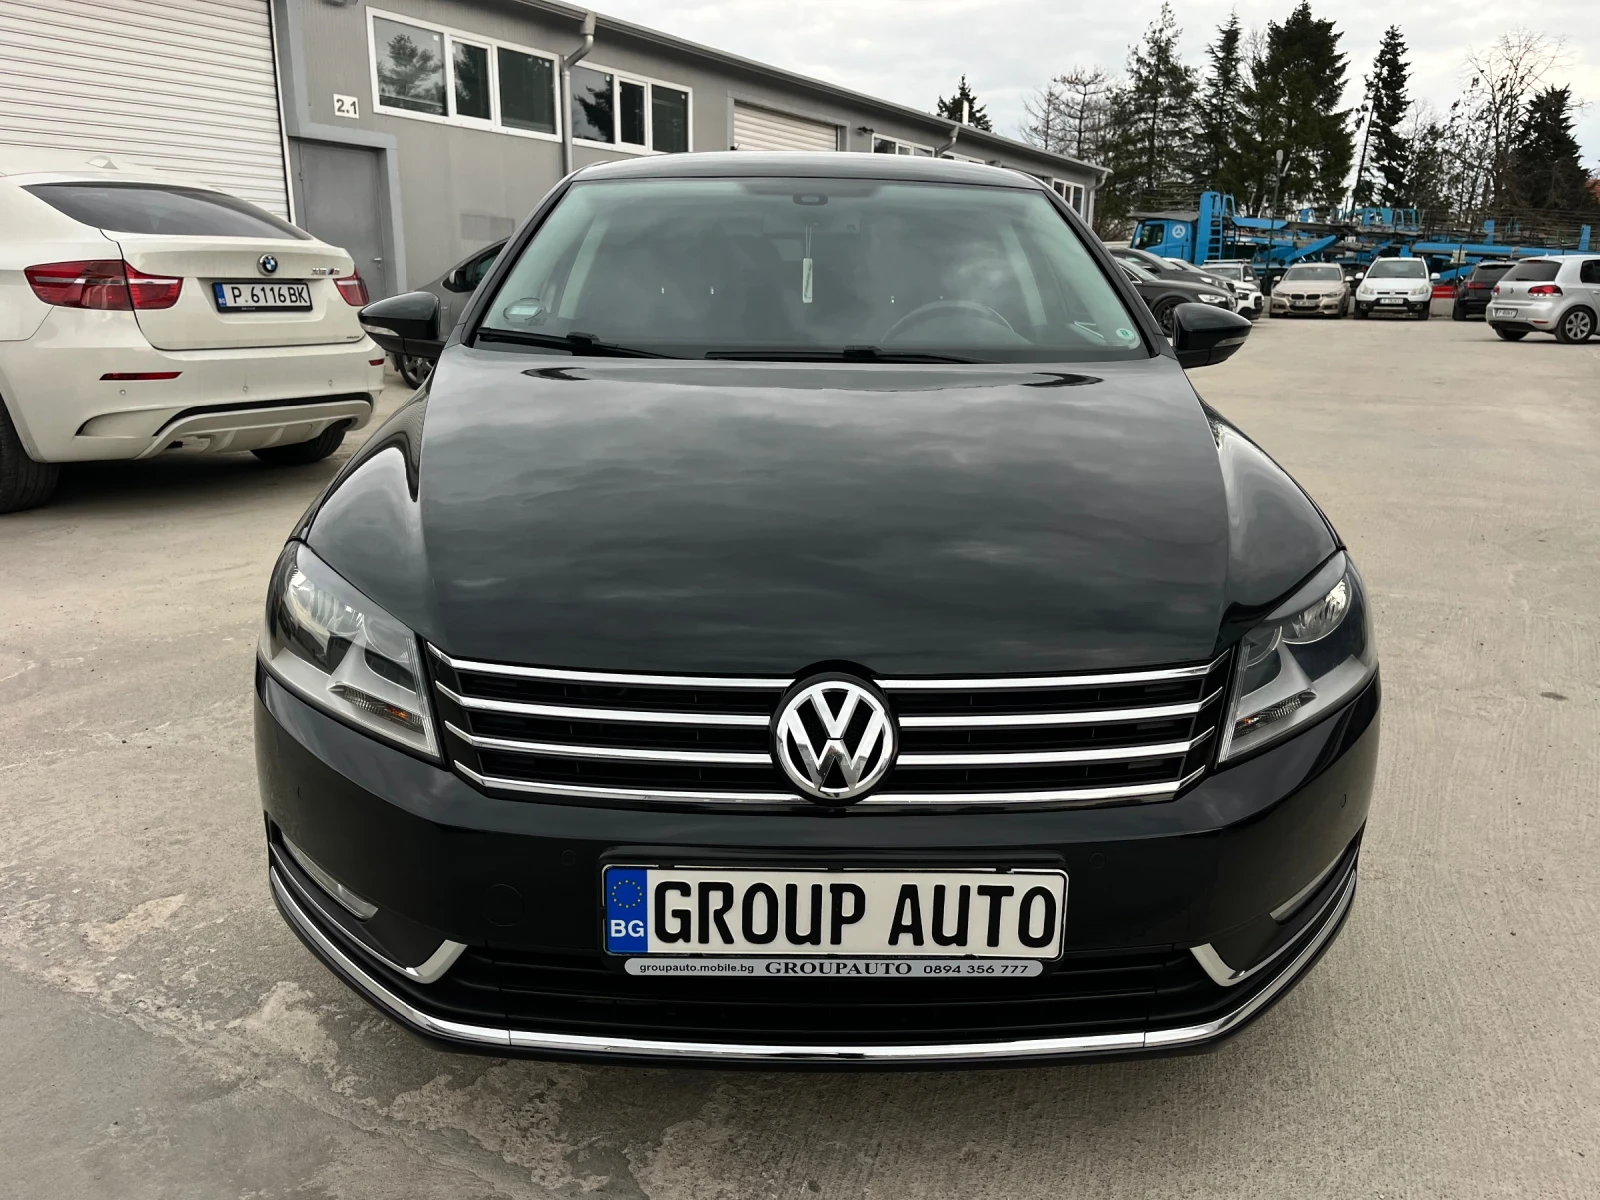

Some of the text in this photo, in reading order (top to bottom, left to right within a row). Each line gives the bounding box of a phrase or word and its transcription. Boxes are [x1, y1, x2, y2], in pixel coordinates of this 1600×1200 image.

[336, 98, 357, 115] 2.1
[610, 881, 1057, 948] BG GROUP AUTO
[639, 961, 1029, 975] groupauto.mobile.bg GROUPAUTO 0894 356 777
